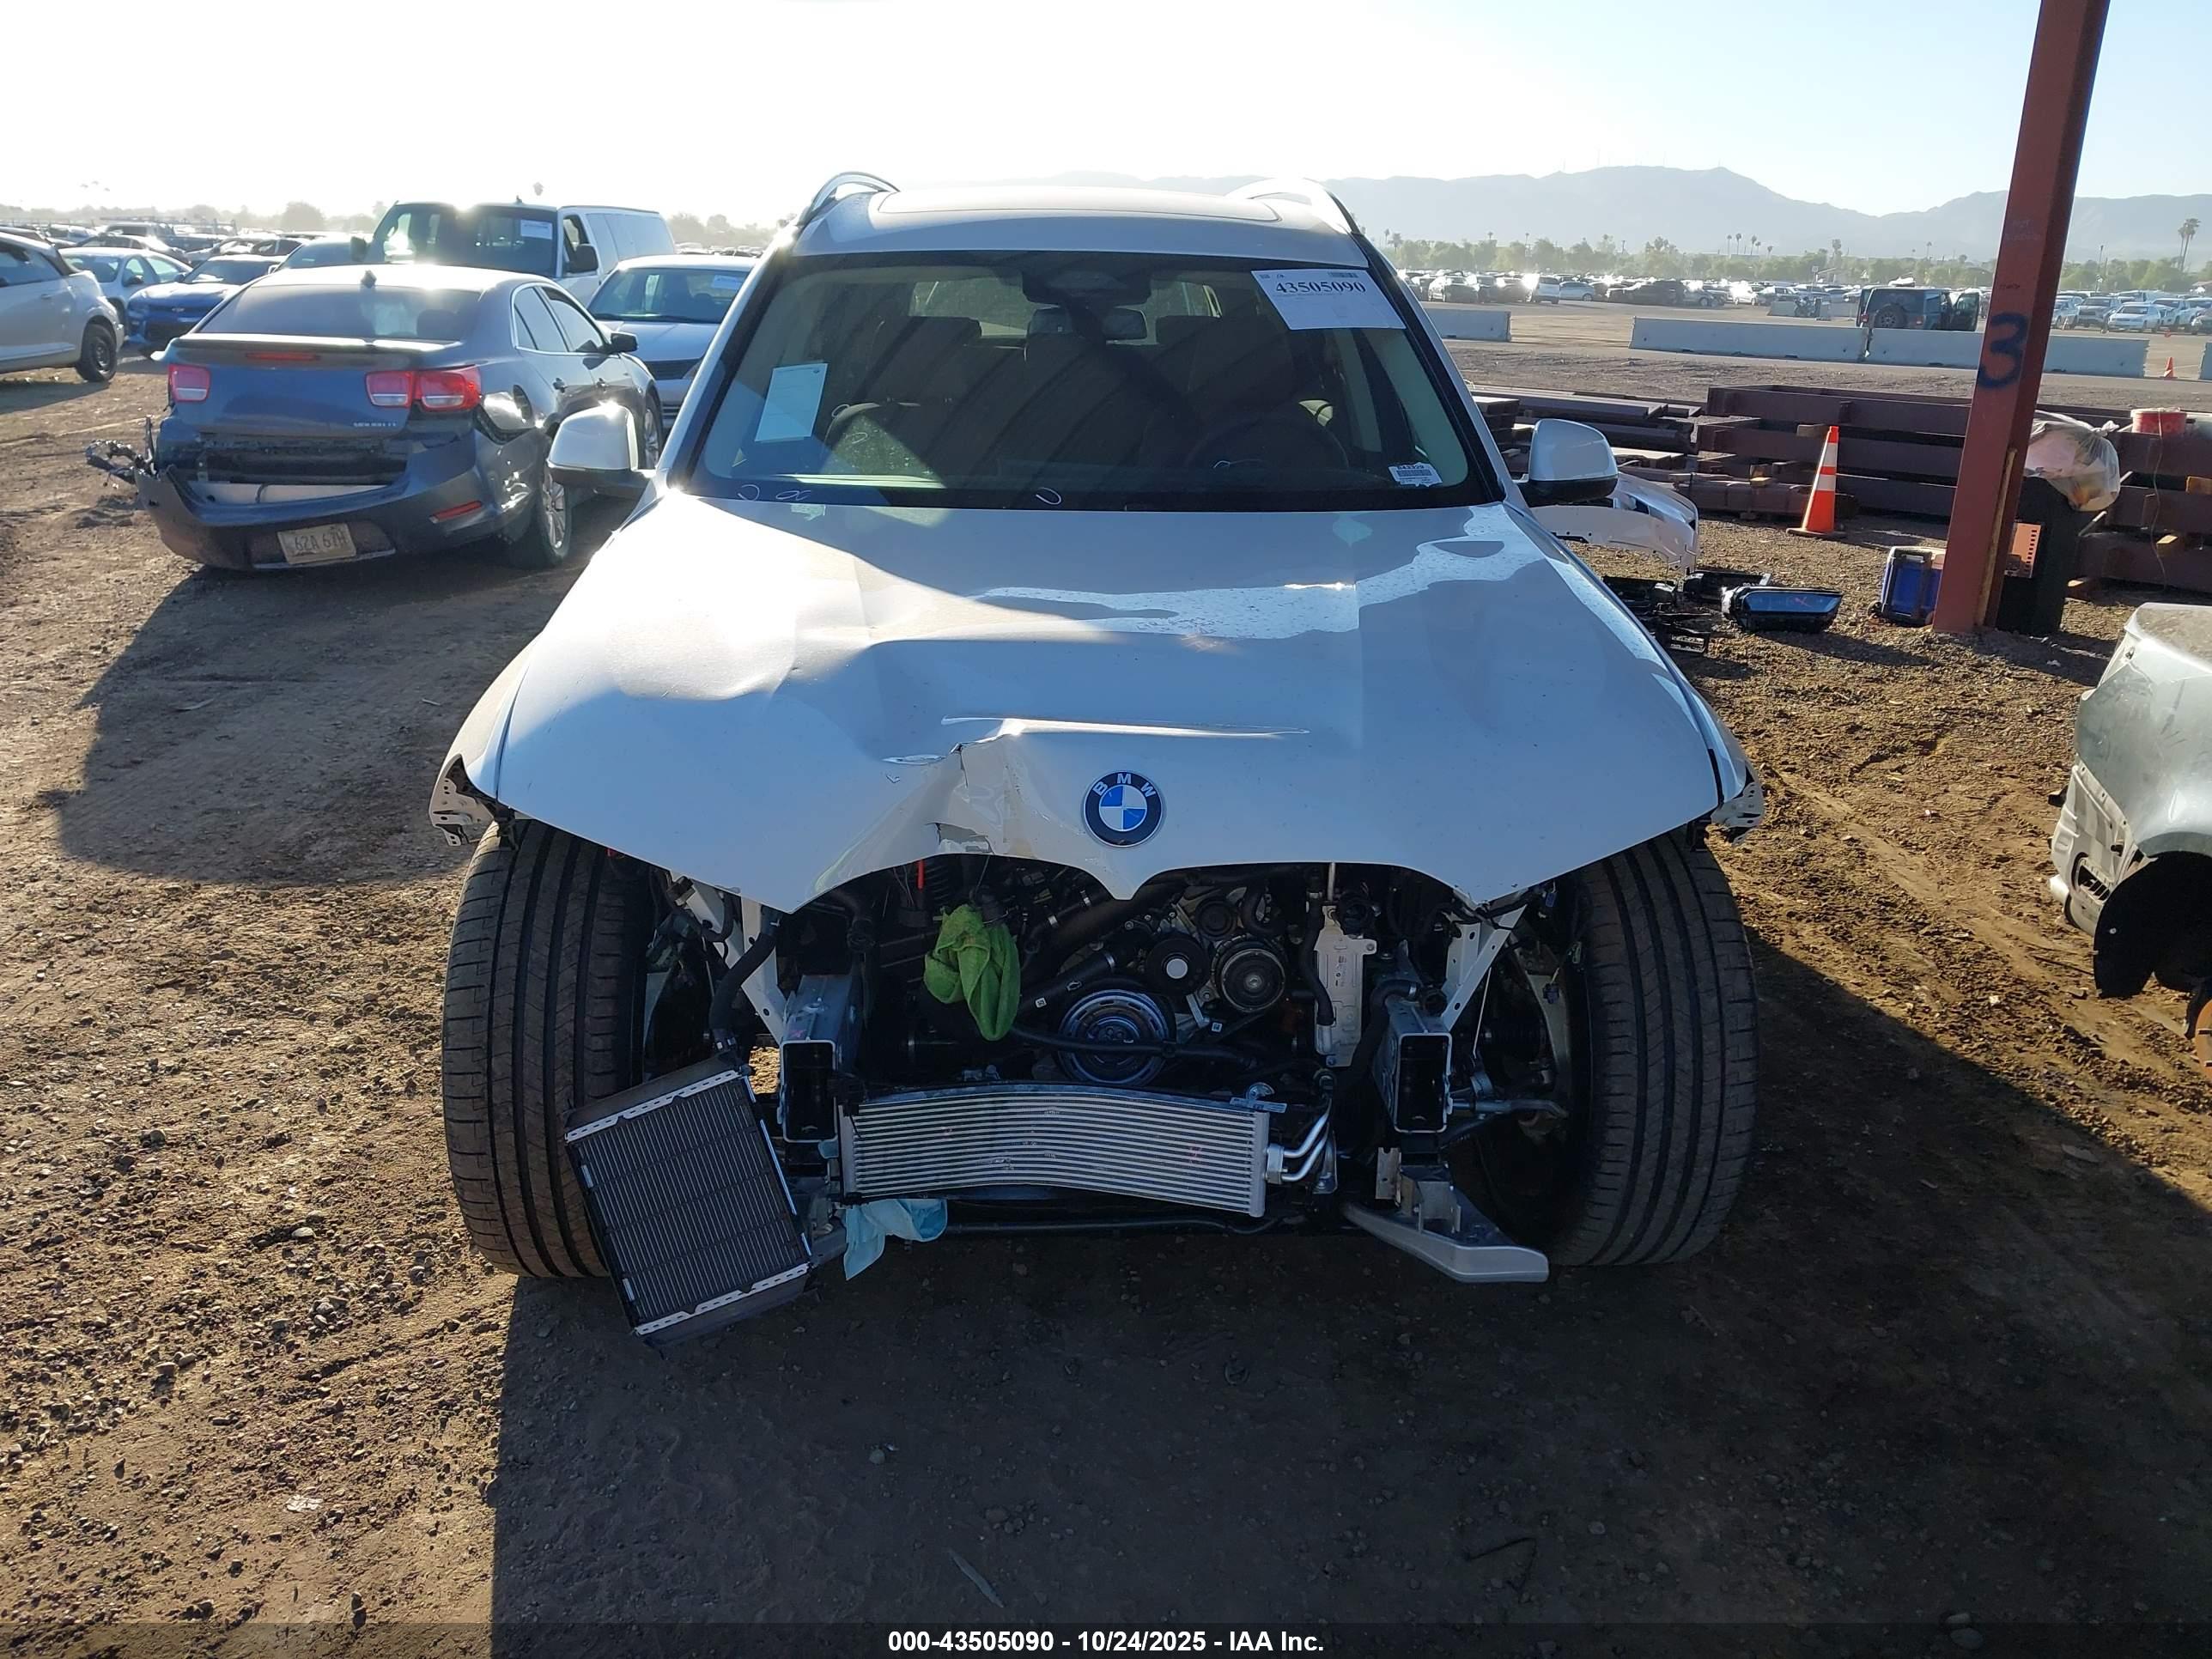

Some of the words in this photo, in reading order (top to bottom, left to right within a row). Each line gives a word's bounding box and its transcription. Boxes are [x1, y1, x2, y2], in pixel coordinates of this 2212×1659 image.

[1276, 281, 1366, 294] 43505090
[1977, 311, 2028, 389] 3
[1092, 773, 1156, 798] BMW
